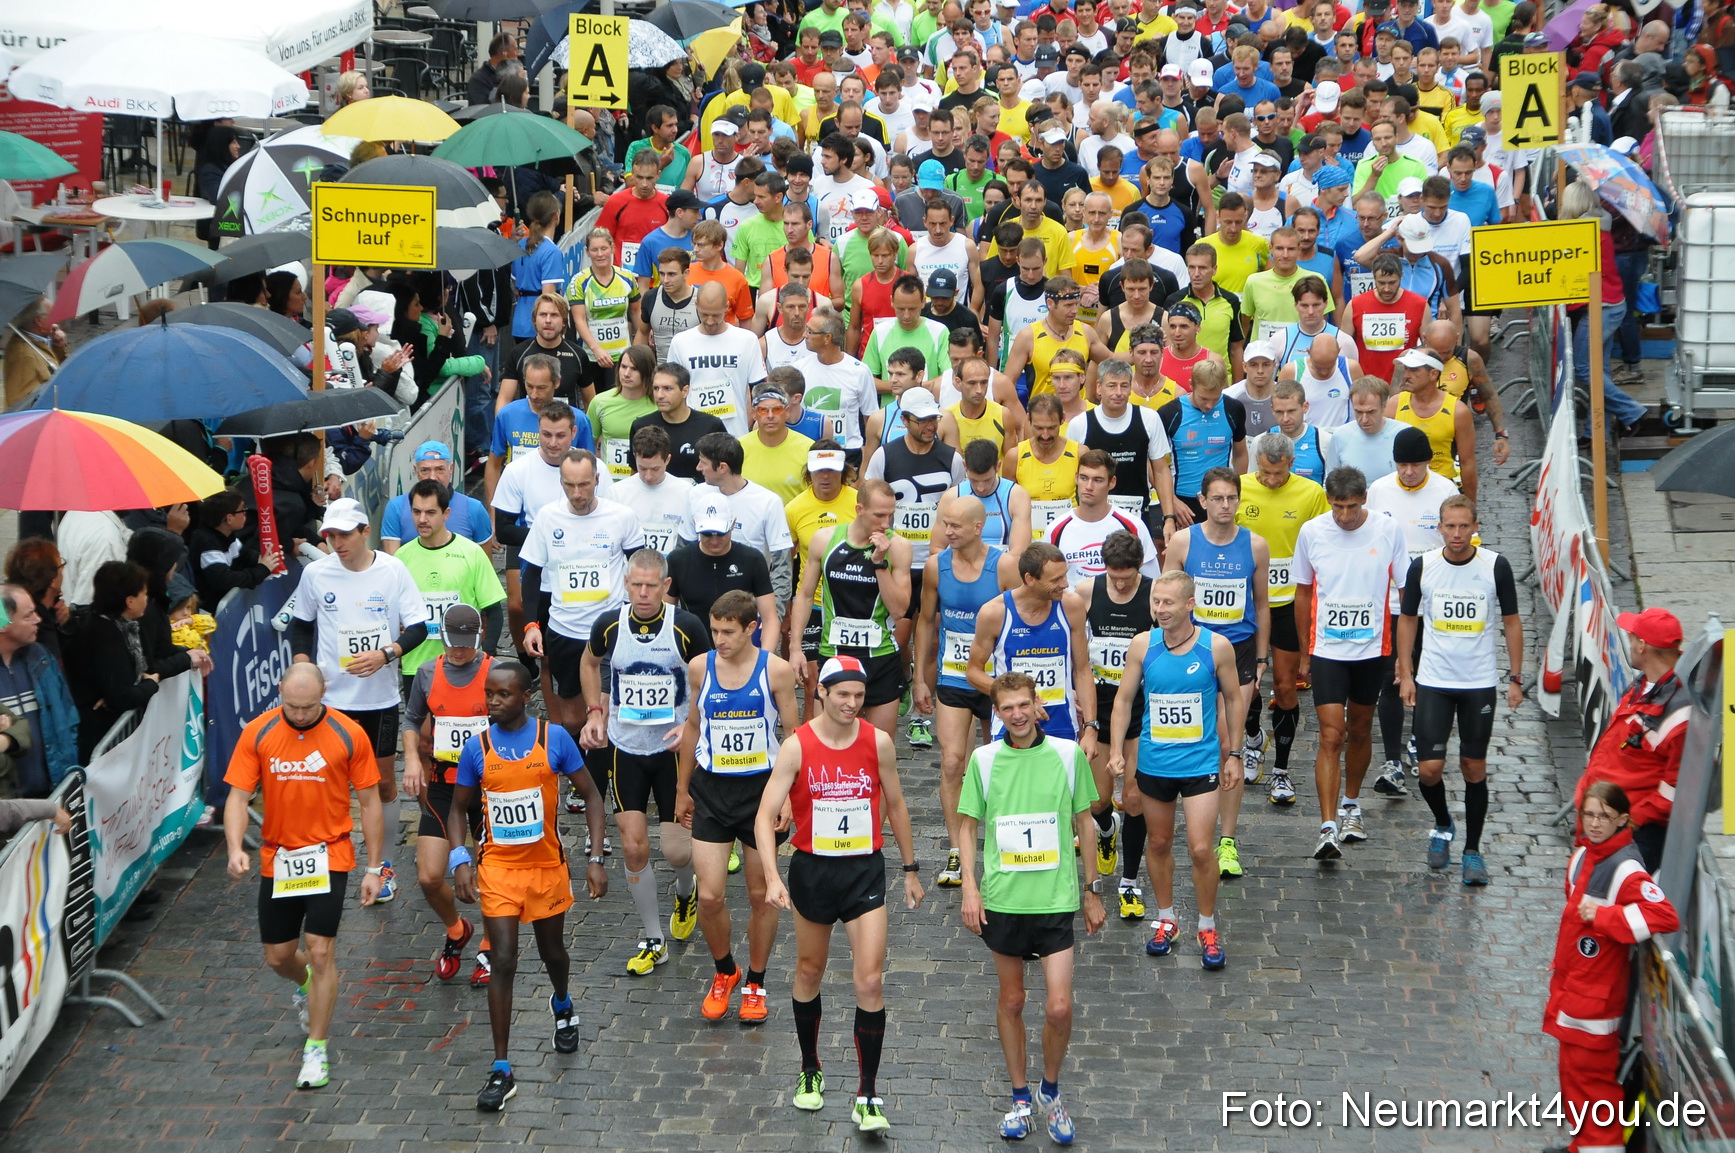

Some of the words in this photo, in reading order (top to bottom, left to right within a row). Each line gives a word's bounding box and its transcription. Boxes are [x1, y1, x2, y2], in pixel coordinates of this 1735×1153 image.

[576, 18, 622, 36] Block
[277, 44, 295, 61] Von
[296, 38, 312, 54] uns,
[581, 43, 615, 87] A
[1508, 57, 1558, 77] Block
[85, 95, 120, 109] Audi
[126, 98, 158, 112] BKK
[1515, 83, 1551, 129] A
[322, 206, 426, 226] Schnupper-
[218, 221, 241, 232] XBOX
[357, 230, 391, 247] lauf
[1479, 243, 1589, 266] Schnupper-
[1517, 267, 1552, 286] lauf
[593, 296, 627, 306] BOCK
[659, 316, 689, 328] PESA
[1371, 322, 1397, 336] 236
[597, 326, 621, 342] 569
[688, 354, 738, 370] THULE
[699, 389, 726, 407] 252
[512, 431, 521, 439] 10.
[1111, 450, 1137, 458] Marathon
[901, 512, 930, 529] 460
[901, 531, 928, 540] Matthias
[845, 563, 863, 573] DAV
[1200, 561, 1242, 571] ELOTEC
[569, 571, 600, 589] 578
[829, 571, 877, 583] Röthenbach
[1269, 568, 1289, 585] 39
[1203, 590, 1236, 606] 500
[1206, 609, 1229, 618] Martin
[1443, 601, 1476, 619] 506
[1327, 610, 1370, 627] 2676
[1445, 622, 1473, 631] Hannes
[348, 634, 381, 655] 587
[840, 629, 869, 646] 541
[1015, 648, 1031, 656] LAC
[1031, 647, 1060, 655] QUELLE
[624, 687, 669, 706] 2132
[709, 692, 728, 700] HEITEC
[728, 709, 757, 718] QUELLE
[1158, 706, 1192, 725] 555
[721, 732, 755, 752] 487
[720, 756, 757, 766] Sebastian
[822, 789, 853, 797] Leichtathletik
[834, 780, 862, 790] Staffelstein
[503, 795, 532, 803] Neumarkt
[492, 801, 538, 825] 2001
[502, 828, 533, 838] Zachary
[837, 815, 850, 835] 4
[834, 839, 851, 849] Uwe
[1022, 827, 1033, 848] 1
[1013, 853, 1046, 863] Michael
[284, 857, 317, 878] 199
[283, 879, 321, 891] Alexander
